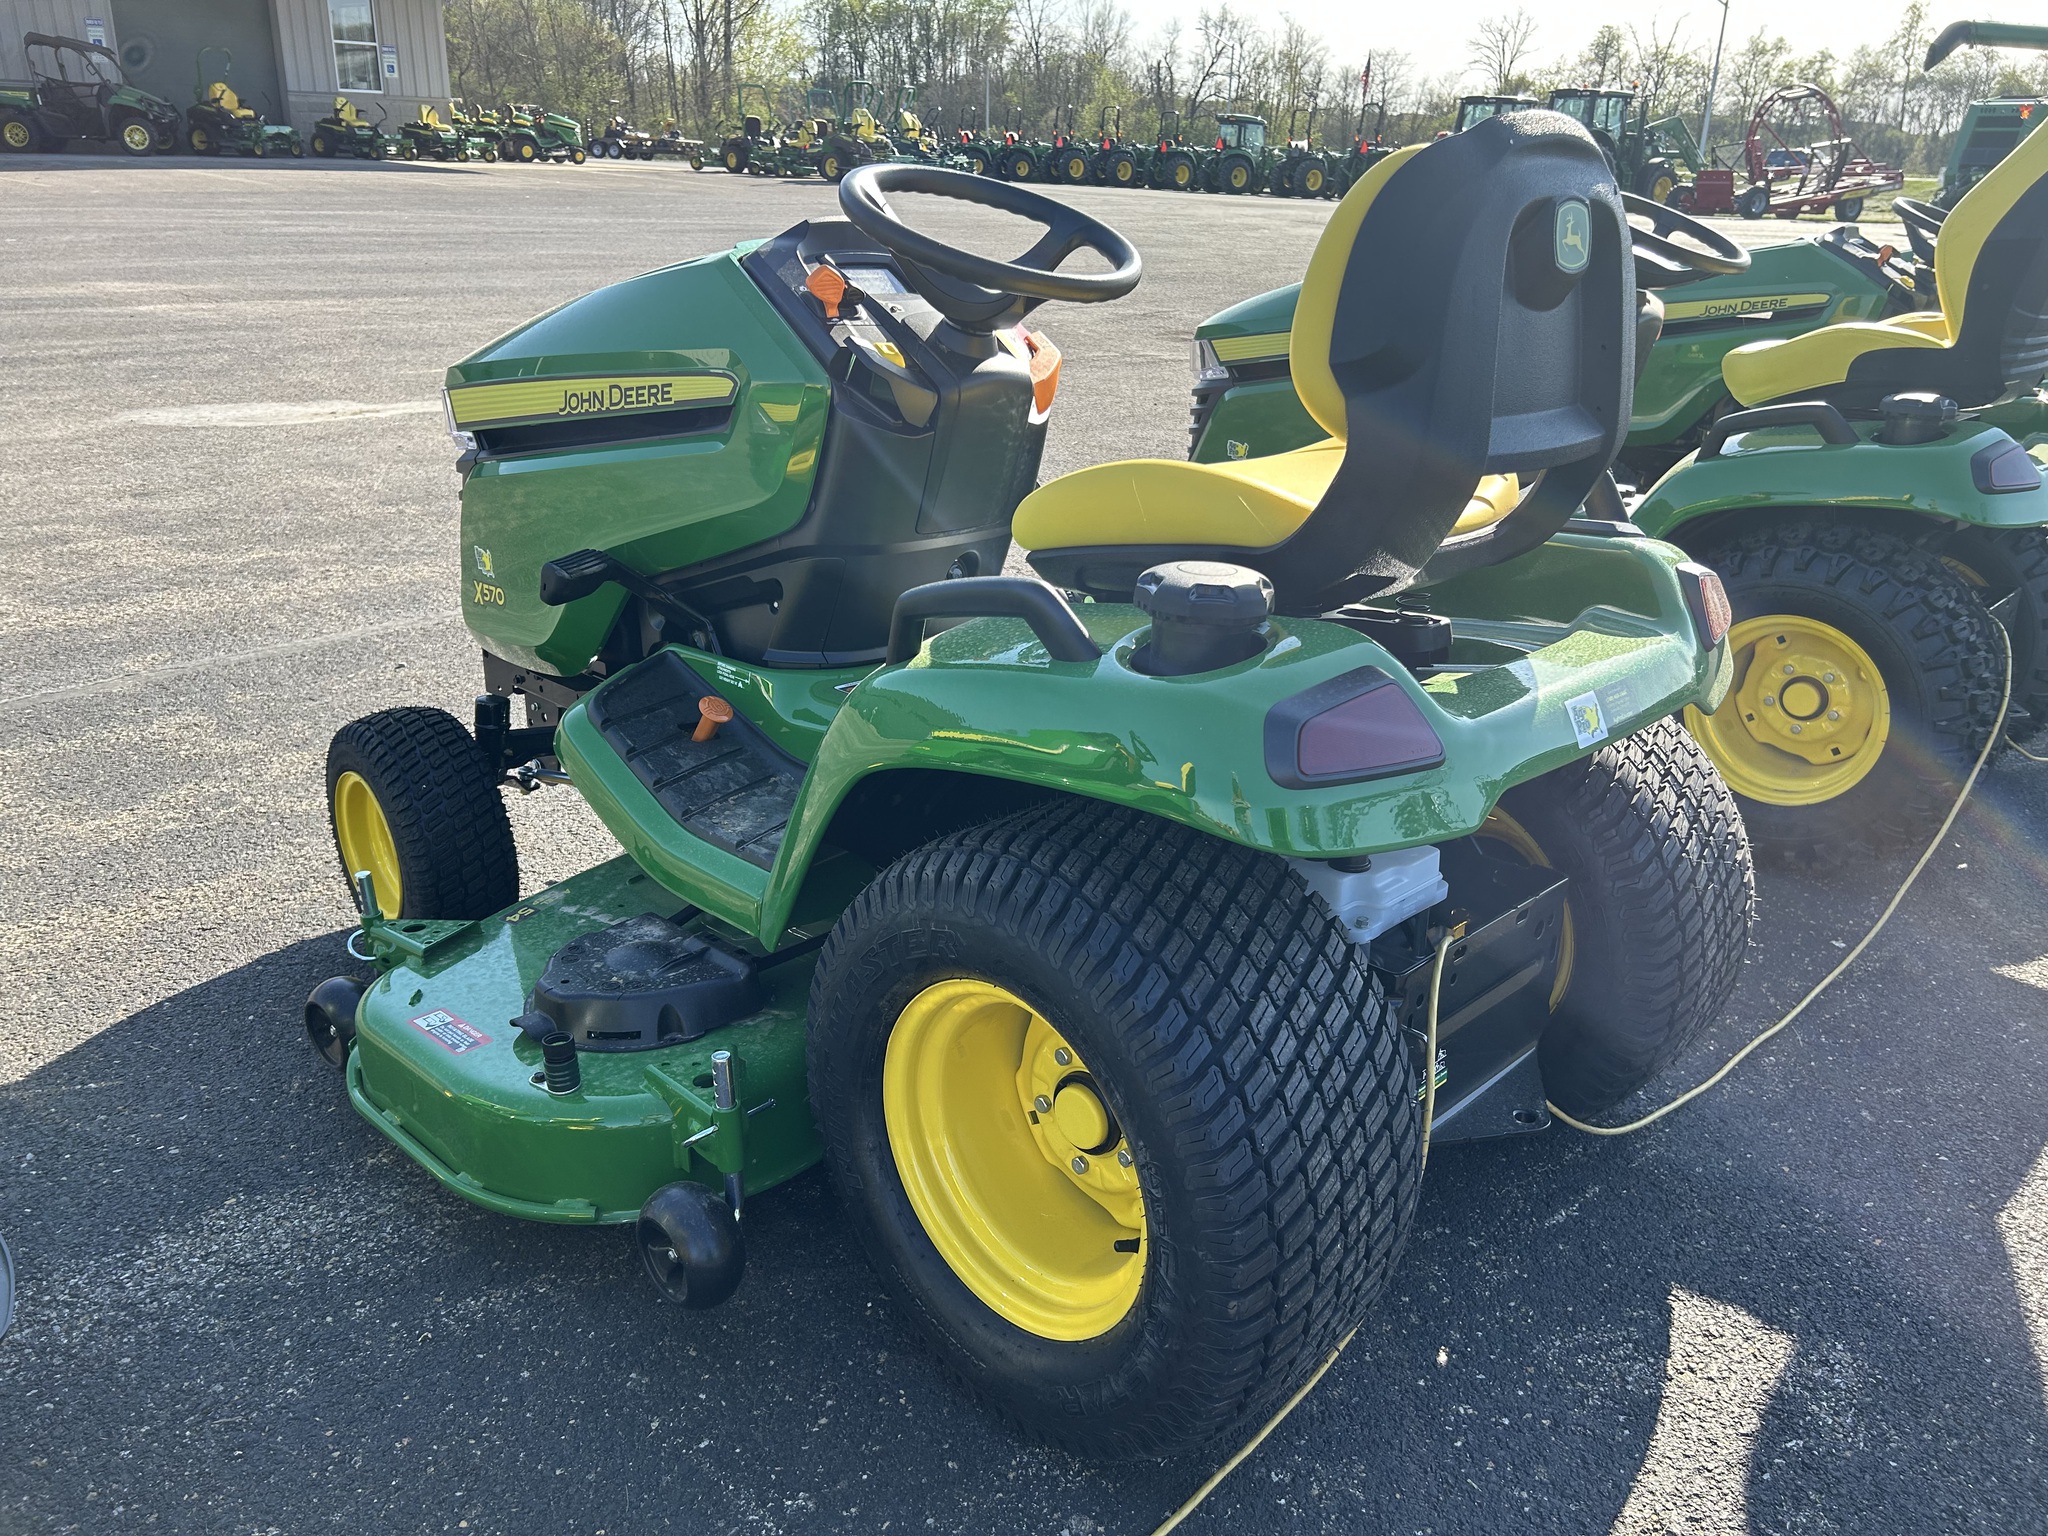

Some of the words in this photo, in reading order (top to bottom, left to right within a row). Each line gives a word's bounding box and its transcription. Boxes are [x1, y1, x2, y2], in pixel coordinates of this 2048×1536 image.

[1702, 304, 1738, 316] JOHN
[1740, 298, 1788, 312] DEERE
[558, 389, 605, 414] JOHN
[608, 383, 673, 409] DEERE
[473, 580, 505, 606] X570
[505, 906, 535, 922] 54
[826, 926, 961, 1043] MASTER
